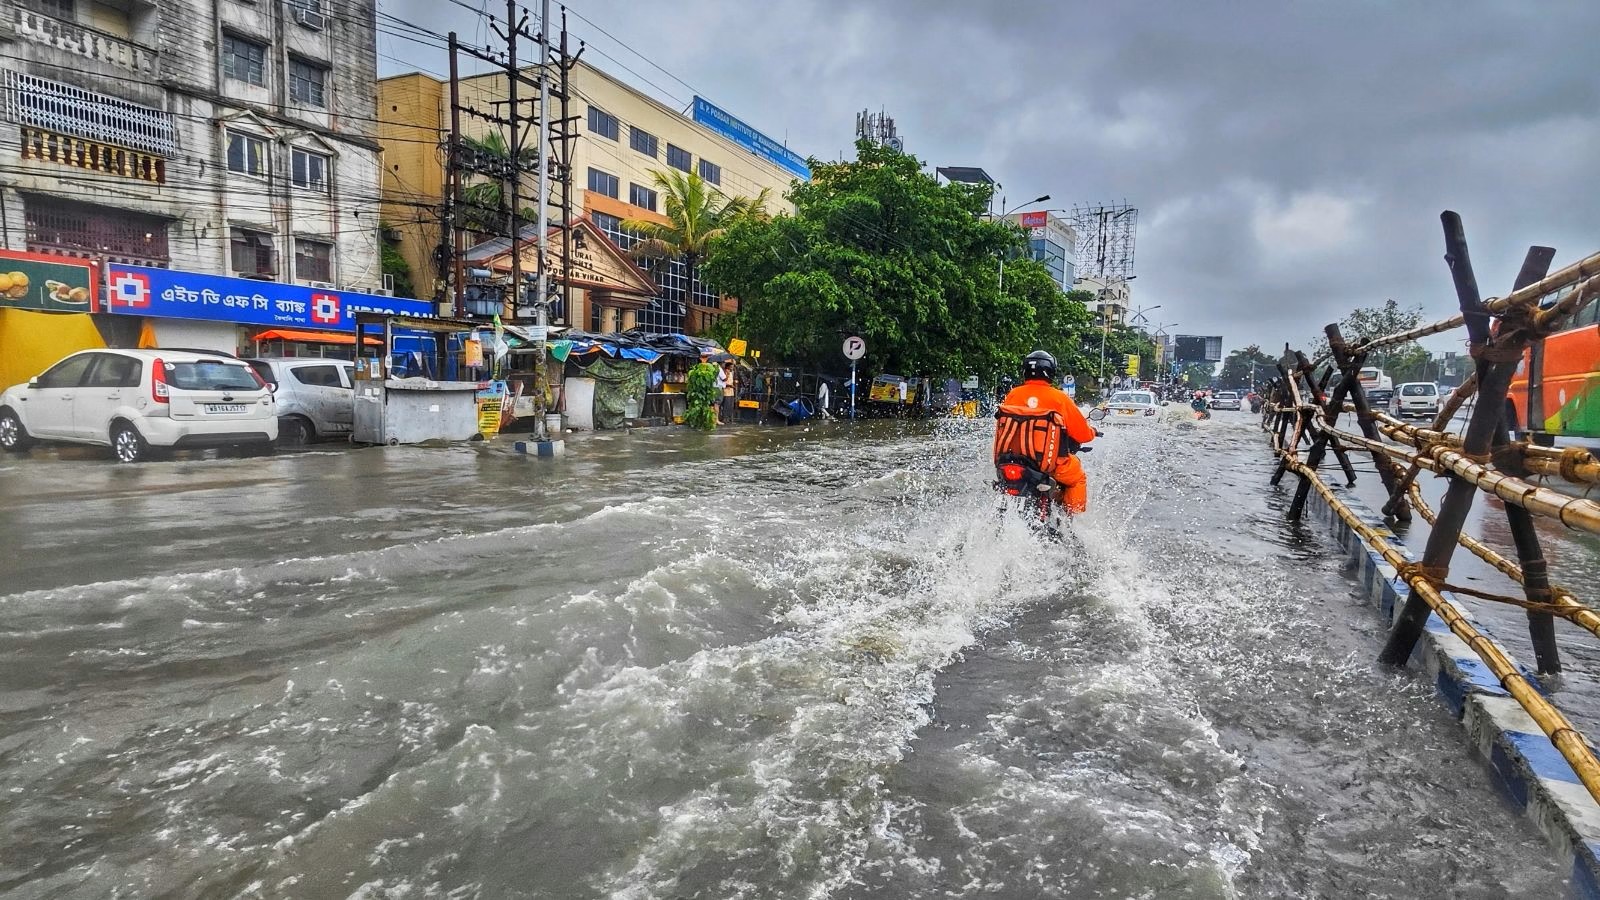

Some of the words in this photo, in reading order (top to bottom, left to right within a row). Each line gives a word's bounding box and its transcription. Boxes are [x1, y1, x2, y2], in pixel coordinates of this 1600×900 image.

[547, 267, 580, 278] PODAR
[582, 272, 604, 282] VIHAR
[161, 285, 199, 302] এইচ
[201, 288, 220, 304] ডি
[223, 295, 249, 308] এফ
[252, 294, 268, 310] সি
